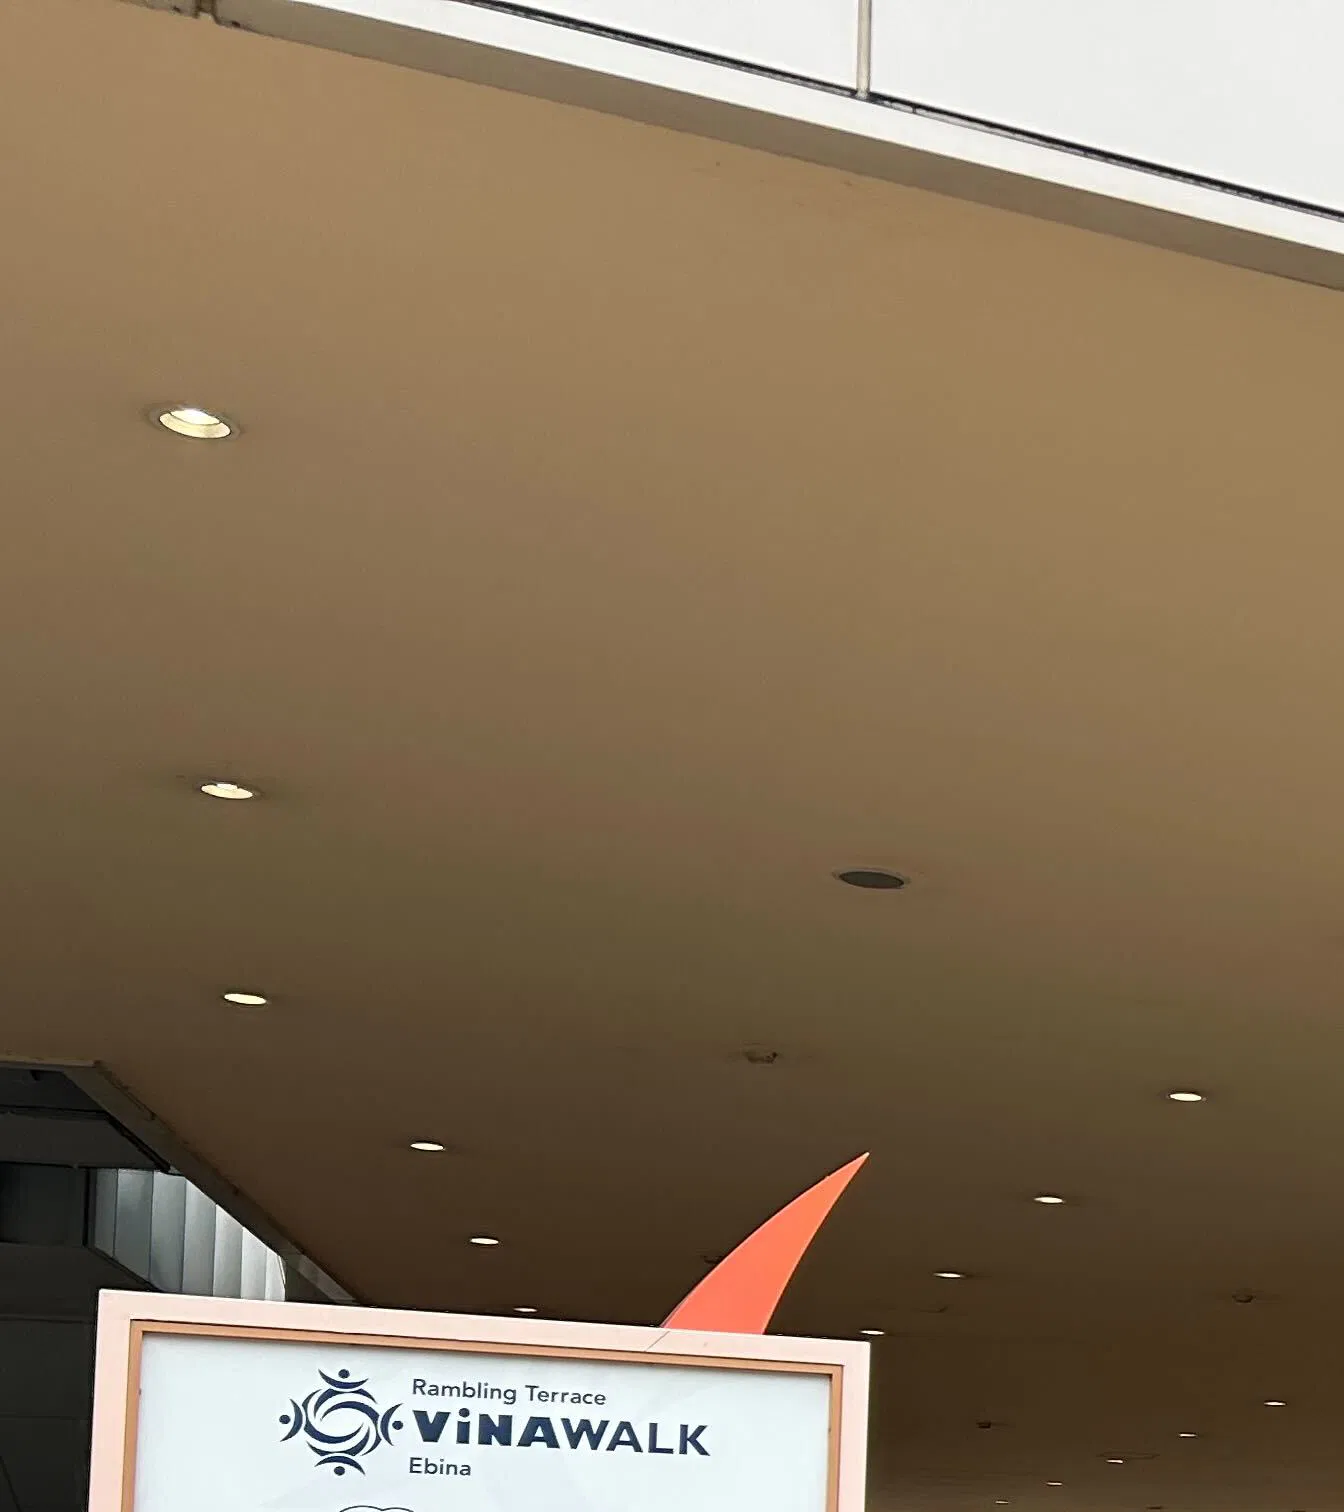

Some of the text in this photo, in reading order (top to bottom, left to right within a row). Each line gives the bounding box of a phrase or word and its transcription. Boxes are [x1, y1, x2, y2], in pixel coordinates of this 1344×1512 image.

[412, 1378, 606, 1406] Rambling Terrace
[409, 1457, 471, 1477] Ebina
